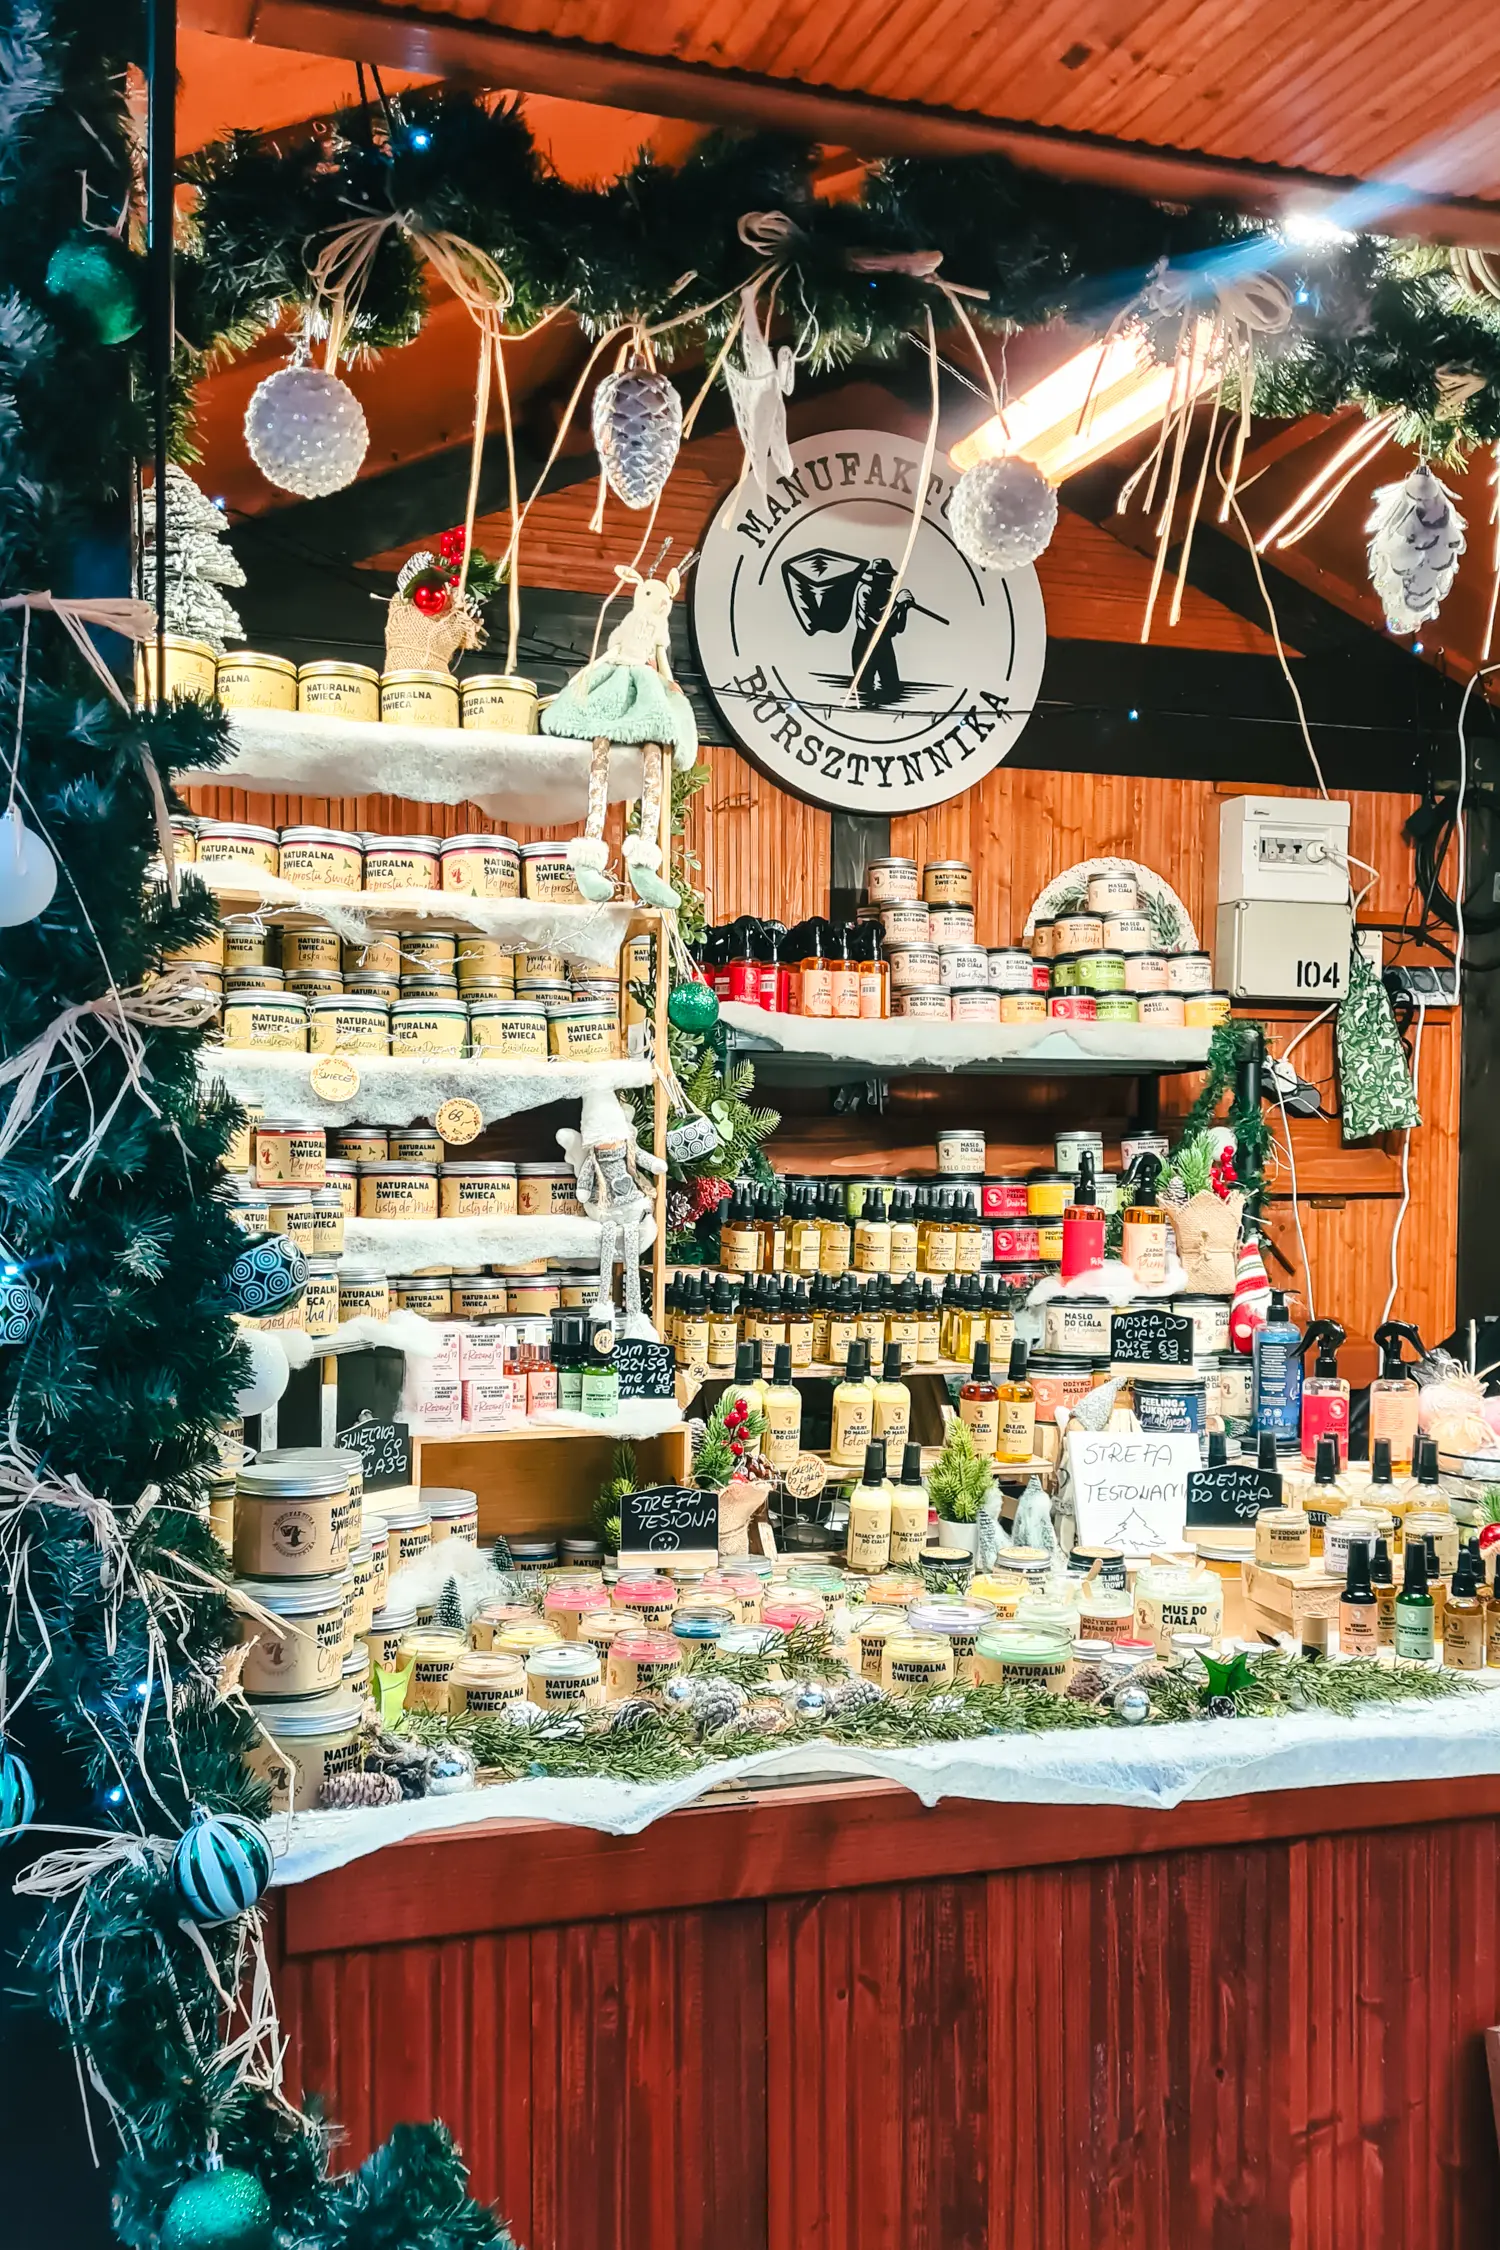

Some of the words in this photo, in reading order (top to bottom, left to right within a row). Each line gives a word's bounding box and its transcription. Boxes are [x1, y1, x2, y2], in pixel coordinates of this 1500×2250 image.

[737, 452, 955, 548] MANUFAKT
[306, 683, 361, 695] NATURALNA
[306, 691, 342, 702] ŚWIECA
[382, 691, 432, 702] NATURALNA
[462, 696, 504, 708] ATURALNA
[733, 665, 1010, 787] BURSZTYNNIKA
[201, 845, 255, 855] NATURALNA
[283, 850, 334, 860] NATURALNA
[283, 860, 313, 869] ŚWIECA
[483, 866, 515, 878] ŚWIECA
[297, 938, 336, 946] NATURALNA
[1296, 959, 1341, 989] 104
[336, 1016, 386, 1027] NATURALNA
[567, 1022, 616, 1034] NATURALNA
[501, 1030, 536, 1040] ŚWIECA
[567, 1032, 603, 1043] ŚWIECA
[290, 1149, 322, 1158] ŚWIECA
[376, 1181, 429, 1190] NATURALNA
[459, 1182, 511, 1191] NATURALNA
[376, 1190, 413, 1199] ŚWIECA
[459, 1190, 496, 1199] ŚWIECA
[1165, 1317, 1188, 1330] DO
[383, 1438, 403, 1459] 69
[1083, 1442, 1173, 1467] STREFA
[1193, 1472, 1260, 1487] OLEJKI
[1191, 1488, 1213, 1502] DO
[630, 1490, 702, 1514] STREFA
[1162, 1604, 1188, 1615] MUS
[1192, 1606, 1207, 1615] DO
[1162, 1615, 1197, 1625] CIAŁA
[892, 1661, 946, 1673] NATURALNA
[1002, 1664, 1066, 1678] NATURALNA
[415, 1672, 448, 1682] ŚWIEC
[545, 1675, 599, 1688] NATURALNA
[892, 1671, 929, 1683] ŚWIECA
[466, 1687, 524, 1700] NATURALNA
[545, 1686, 586, 1699] ŚWIECA
[466, 1699, 507, 1711] ŚWIECA
